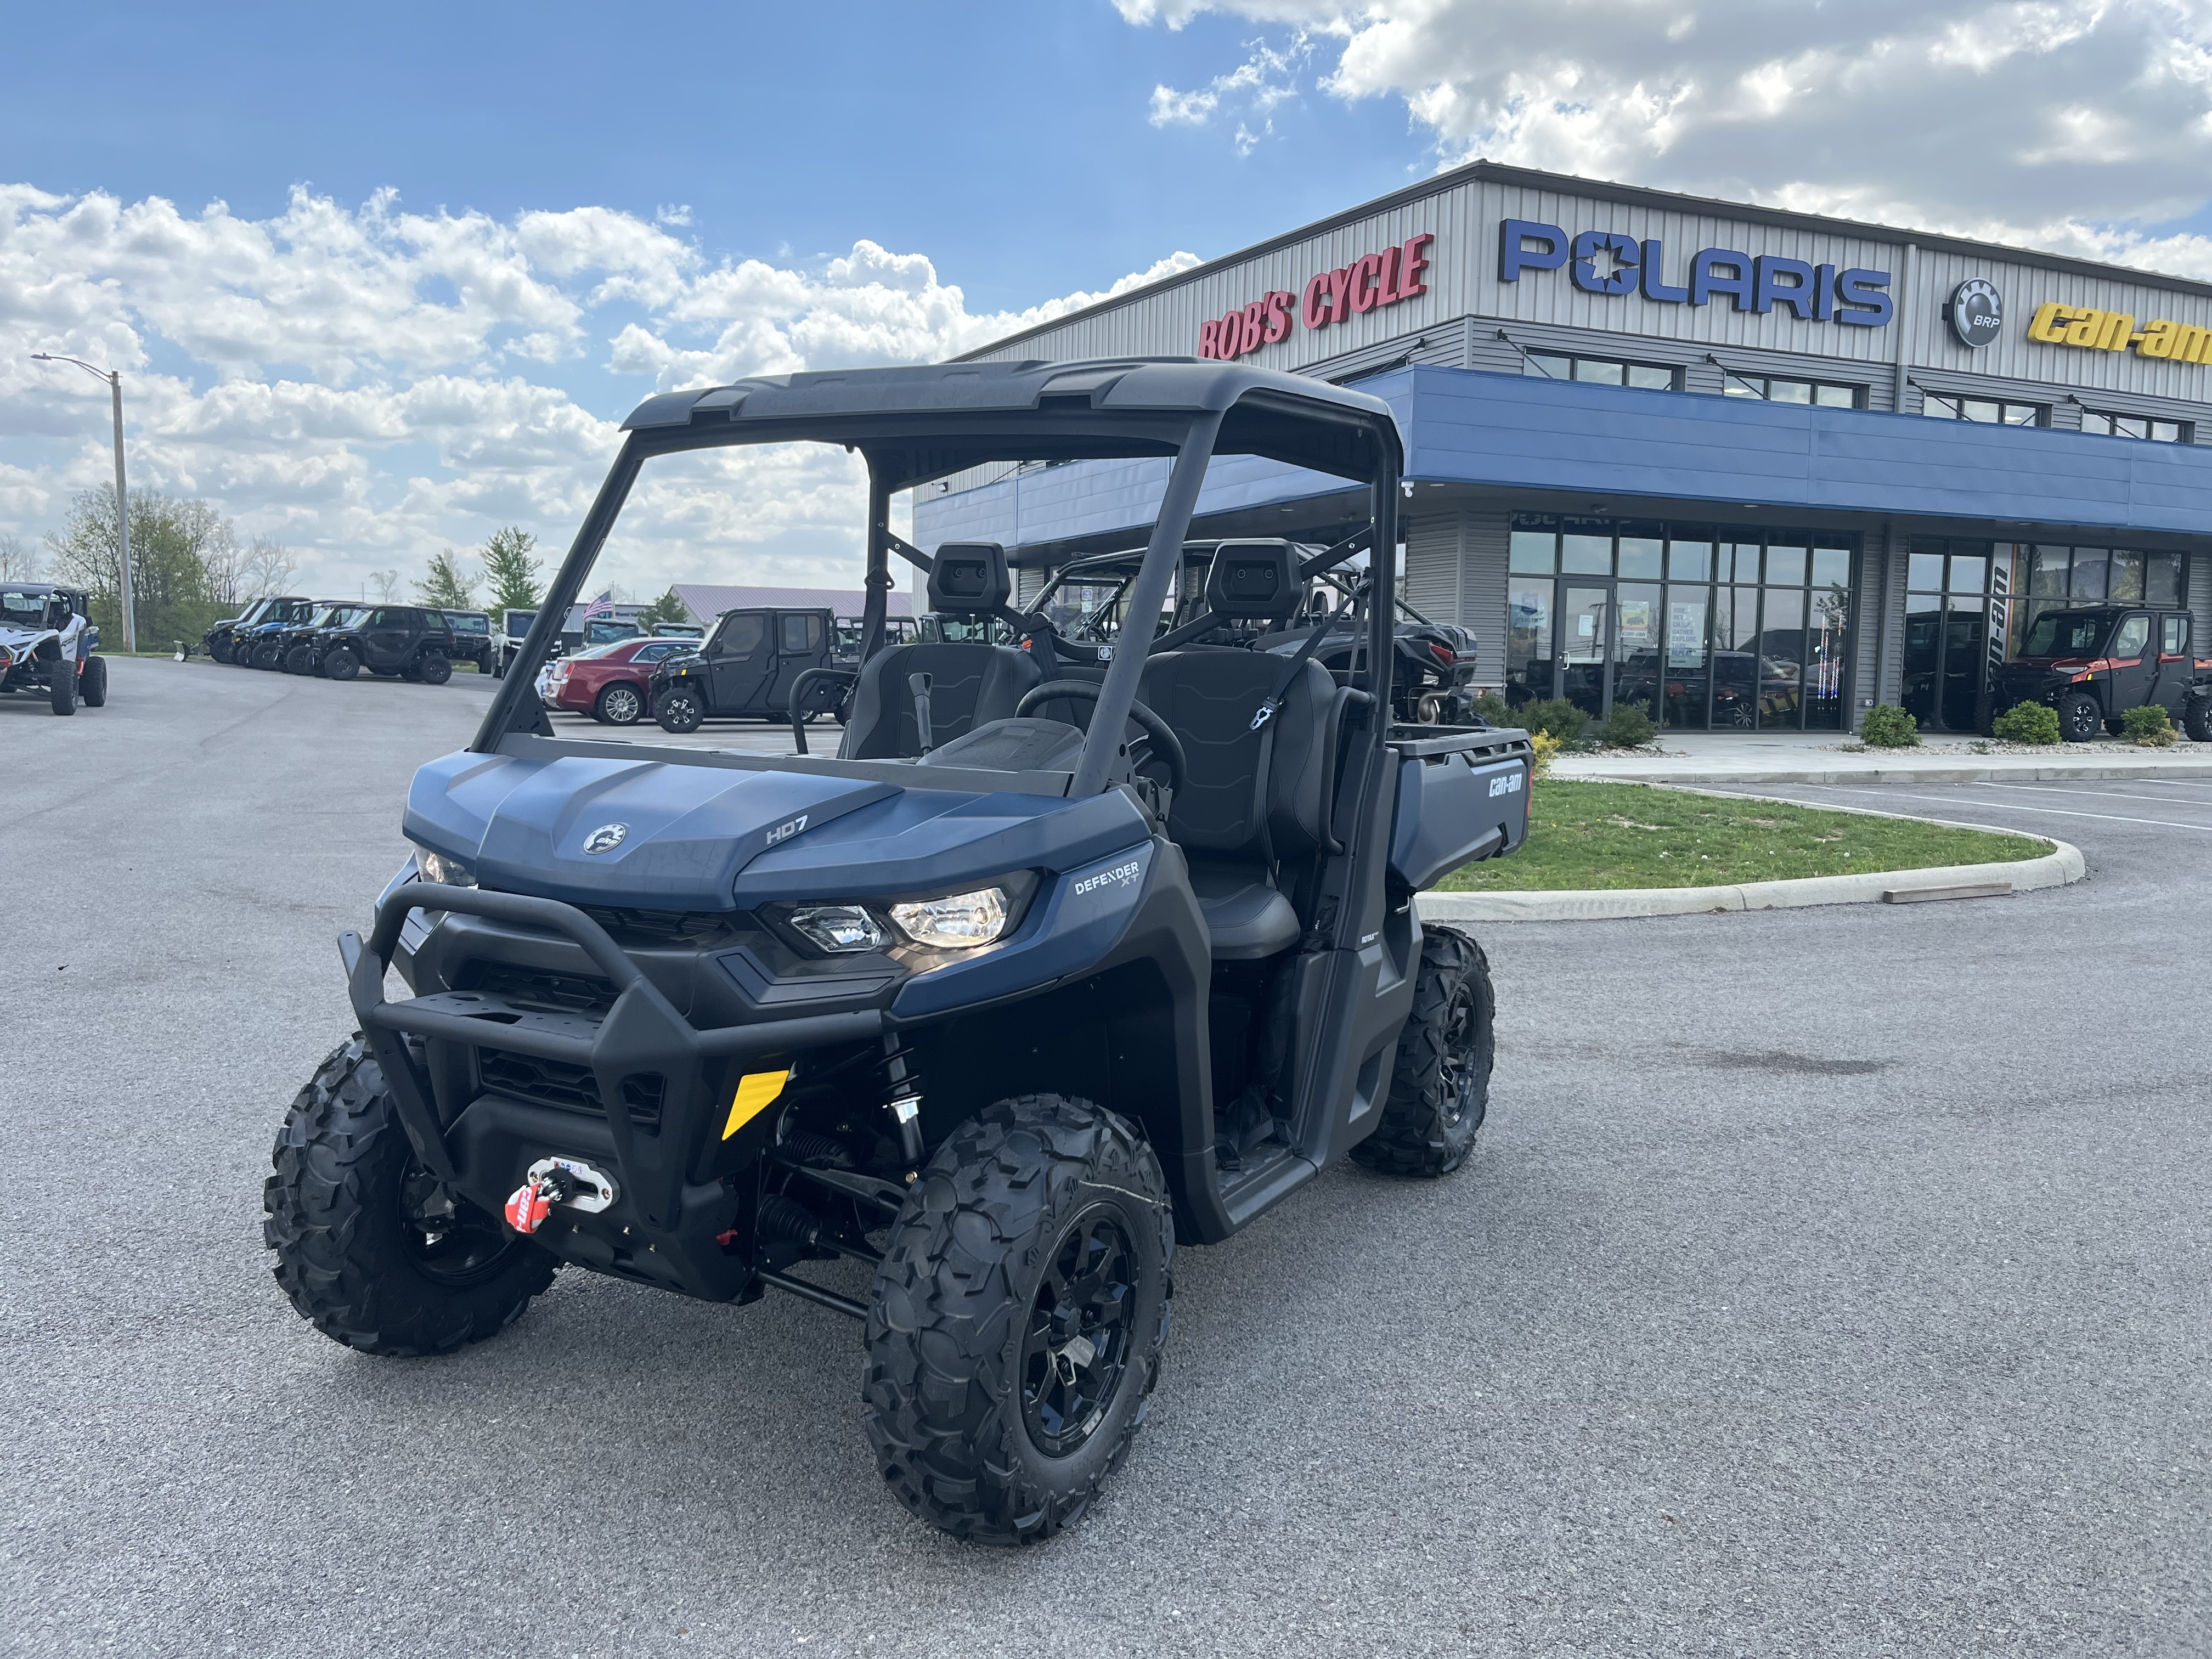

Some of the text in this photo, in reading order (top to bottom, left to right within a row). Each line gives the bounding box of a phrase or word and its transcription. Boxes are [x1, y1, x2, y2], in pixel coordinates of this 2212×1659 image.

[1498, 218, 1893, 328] POLARIS
[1198, 233, 1435, 361] BOB'S CYCLE
[1973, 314, 2001, 329] BRP
[1488, 772, 1522, 798] can-am
[766, 815, 808, 845] HD7
[1075, 861, 1139, 895] DEFENDER
[1121, 872, 1139, 888] XT
